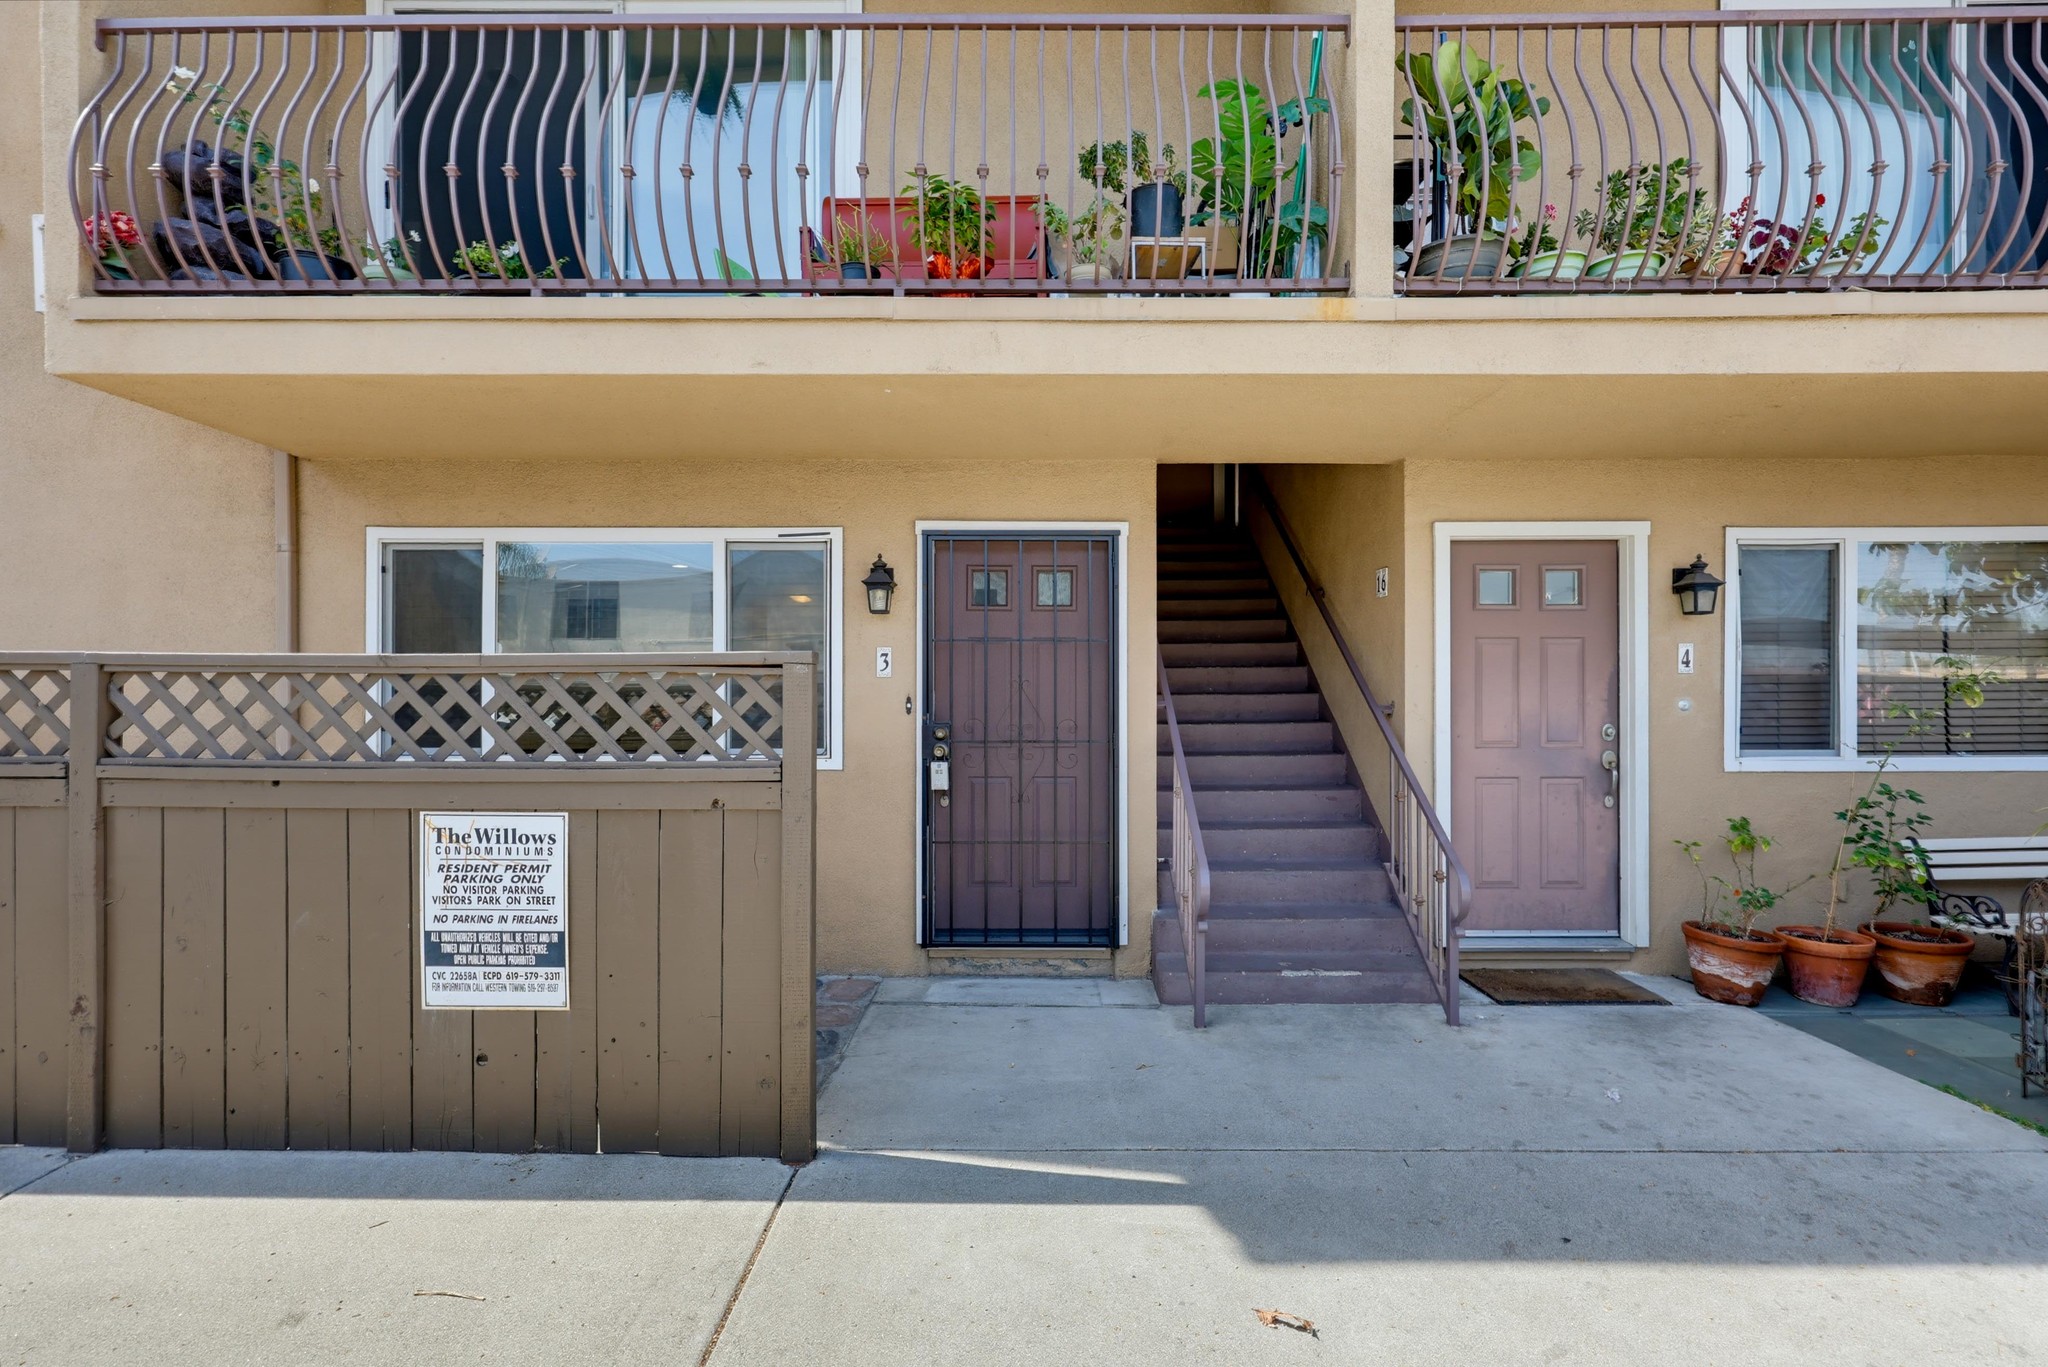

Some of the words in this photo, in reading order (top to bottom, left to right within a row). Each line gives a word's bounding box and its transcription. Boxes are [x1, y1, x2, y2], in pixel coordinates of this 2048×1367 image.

[1377, 574, 1386, 592] 16
[880, 653, 889, 671] 3
[1682, 649, 1691, 667] 4
[433, 827, 471, 844] The
[474, 827, 556, 845] Willows
[435, 846, 553, 856] CONDOMINIUMS
[437, 864, 499, 873] RESIDENT
[504, 864, 552, 873] PERMIT
[443, 875, 503, 883] PARKING
[511, 875, 545, 884] ONLY
[443, 885, 458, 894] NO
[463, 885, 497, 894] VISITOR
[503, 886, 544, 894] PARKING
[432, 896, 472, 905] VISITORS
[477, 896, 501, 905] PARK
[507, 896, 521, 905] ON
[526, 896, 556, 905] STREET
[433, 915, 448, 923] NO
[452, 915, 494, 924] PARKING
[498, 915, 508, 924] IN
[512, 915, 558, 924] FIRELANES
[431, 932, 440, 942] ALL
[441, 932, 477, 942] UNAUTHORIZED
[478, 932, 501, 942] VEHICLES
[503, 933, 514, 942] WILL
[515, 933, 522, 943] BE
[524, 933, 538, 943] CITED
[441, 943, 457, 954] TOWED
[459, 943, 472, 954] AWAY
[473, 944, 480, 954] AT
[481, 944, 501, 954] VEHICLE
[502, 944, 524, 954] OWNER'S
[525, 944, 549, 954] EXPENSE.
[454, 955, 467, 965] OPEN
[468, 955, 485, 965] PUBLIC
[486, 955, 507, 965] PARKING
[508, 955, 536, 965] PROHIBITED
[432, 972, 446, 980] CVC
[450, 972, 477, 980] 22658A
[483, 972, 502, 980] ECPD
[506, 972, 560, 980] 619-579-3311
[432, 983, 441, 991] FOR
[442, 983, 471, 992] INFORMATION
[472, 983, 484, 992] CALL
[485, 983, 507, 992] WESTERN
[509, 984, 526, 992] TOWING
